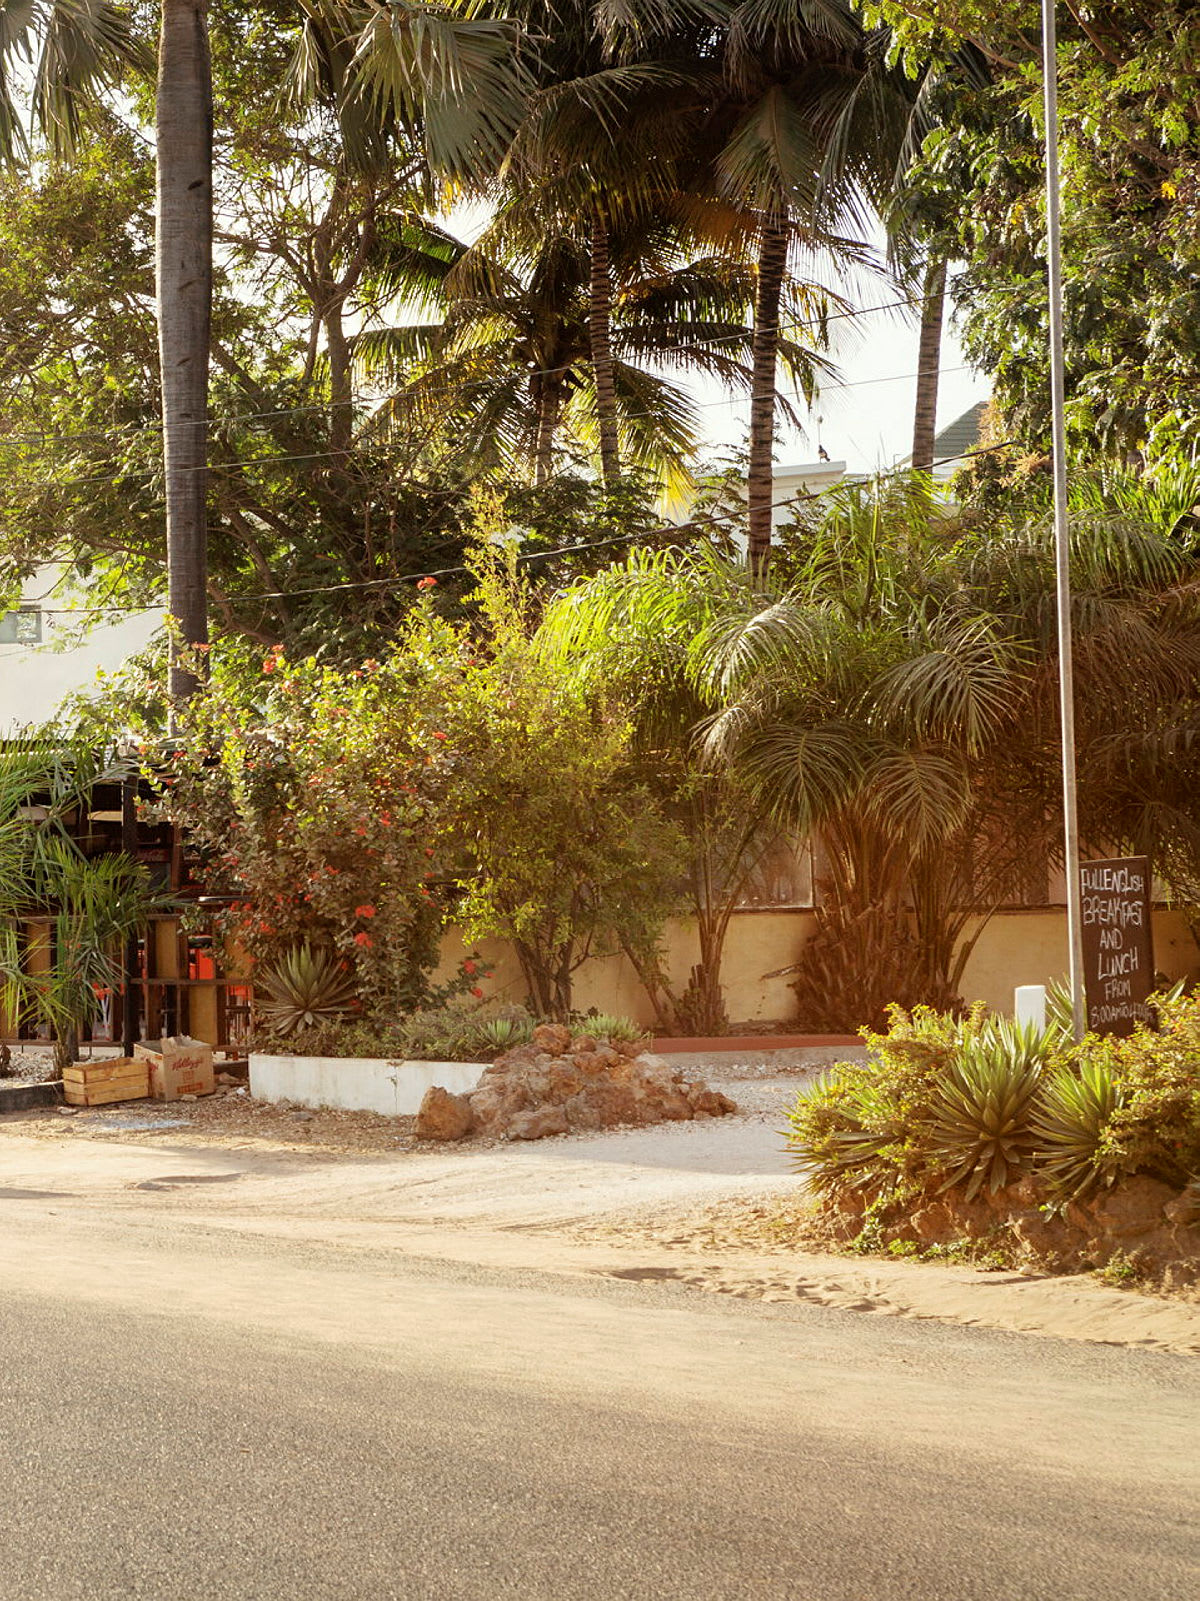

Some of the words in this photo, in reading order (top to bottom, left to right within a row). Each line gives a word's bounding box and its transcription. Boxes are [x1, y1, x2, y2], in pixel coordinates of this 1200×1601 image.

[1082, 895, 1144, 928] BREAKFAST
[1100, 928, 1123, 950] AND
[1098, 946, 1139, 980] LUNCH
[1105, 978, 1131, 1001] FROM
